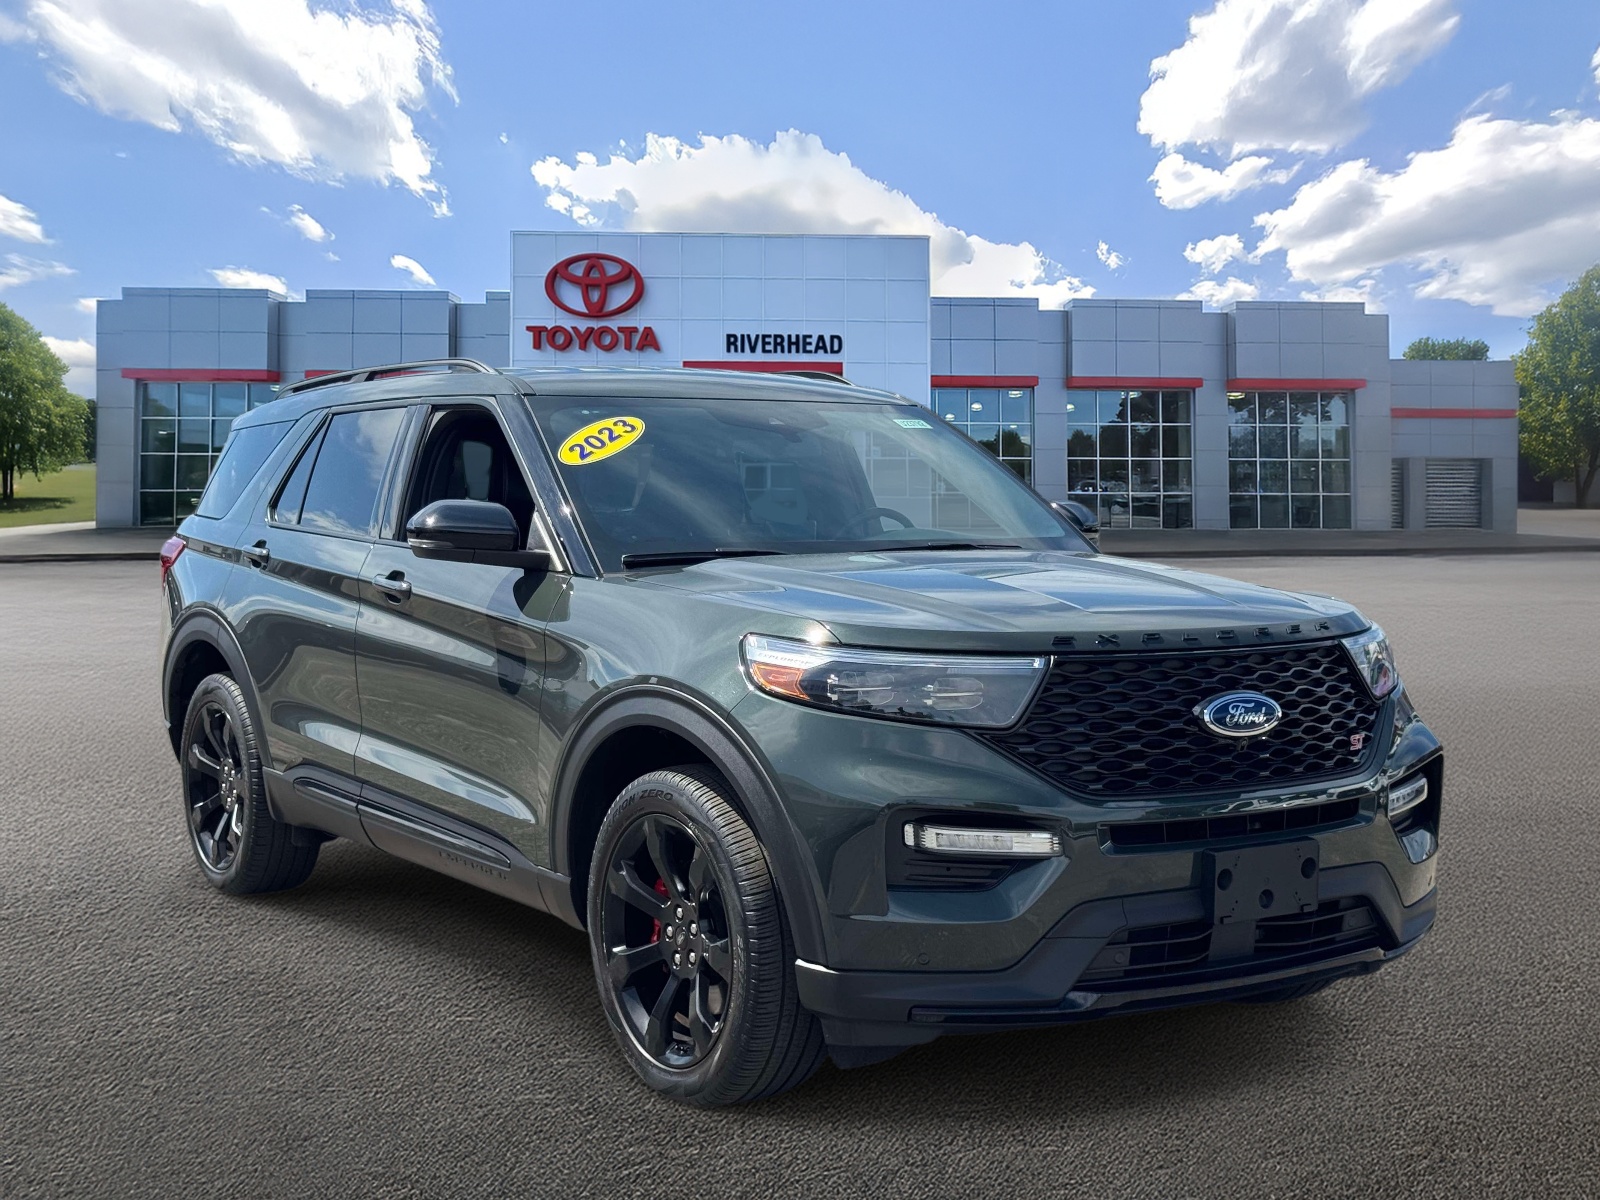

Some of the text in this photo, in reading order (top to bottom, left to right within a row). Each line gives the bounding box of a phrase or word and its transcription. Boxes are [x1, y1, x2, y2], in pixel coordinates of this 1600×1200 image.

[525, 325, 661, 352] TOYOTA
[726, 333, 843, 355] RIVERHEAD
[568, 419, 637, 461] 2023
[1051, 621, 1330, 647] EXPLORER
[1226, 702, 1268, 725] Ford
[1350, 733, 1364, 751] ST
[639, 788, 674, 801] ZERO
